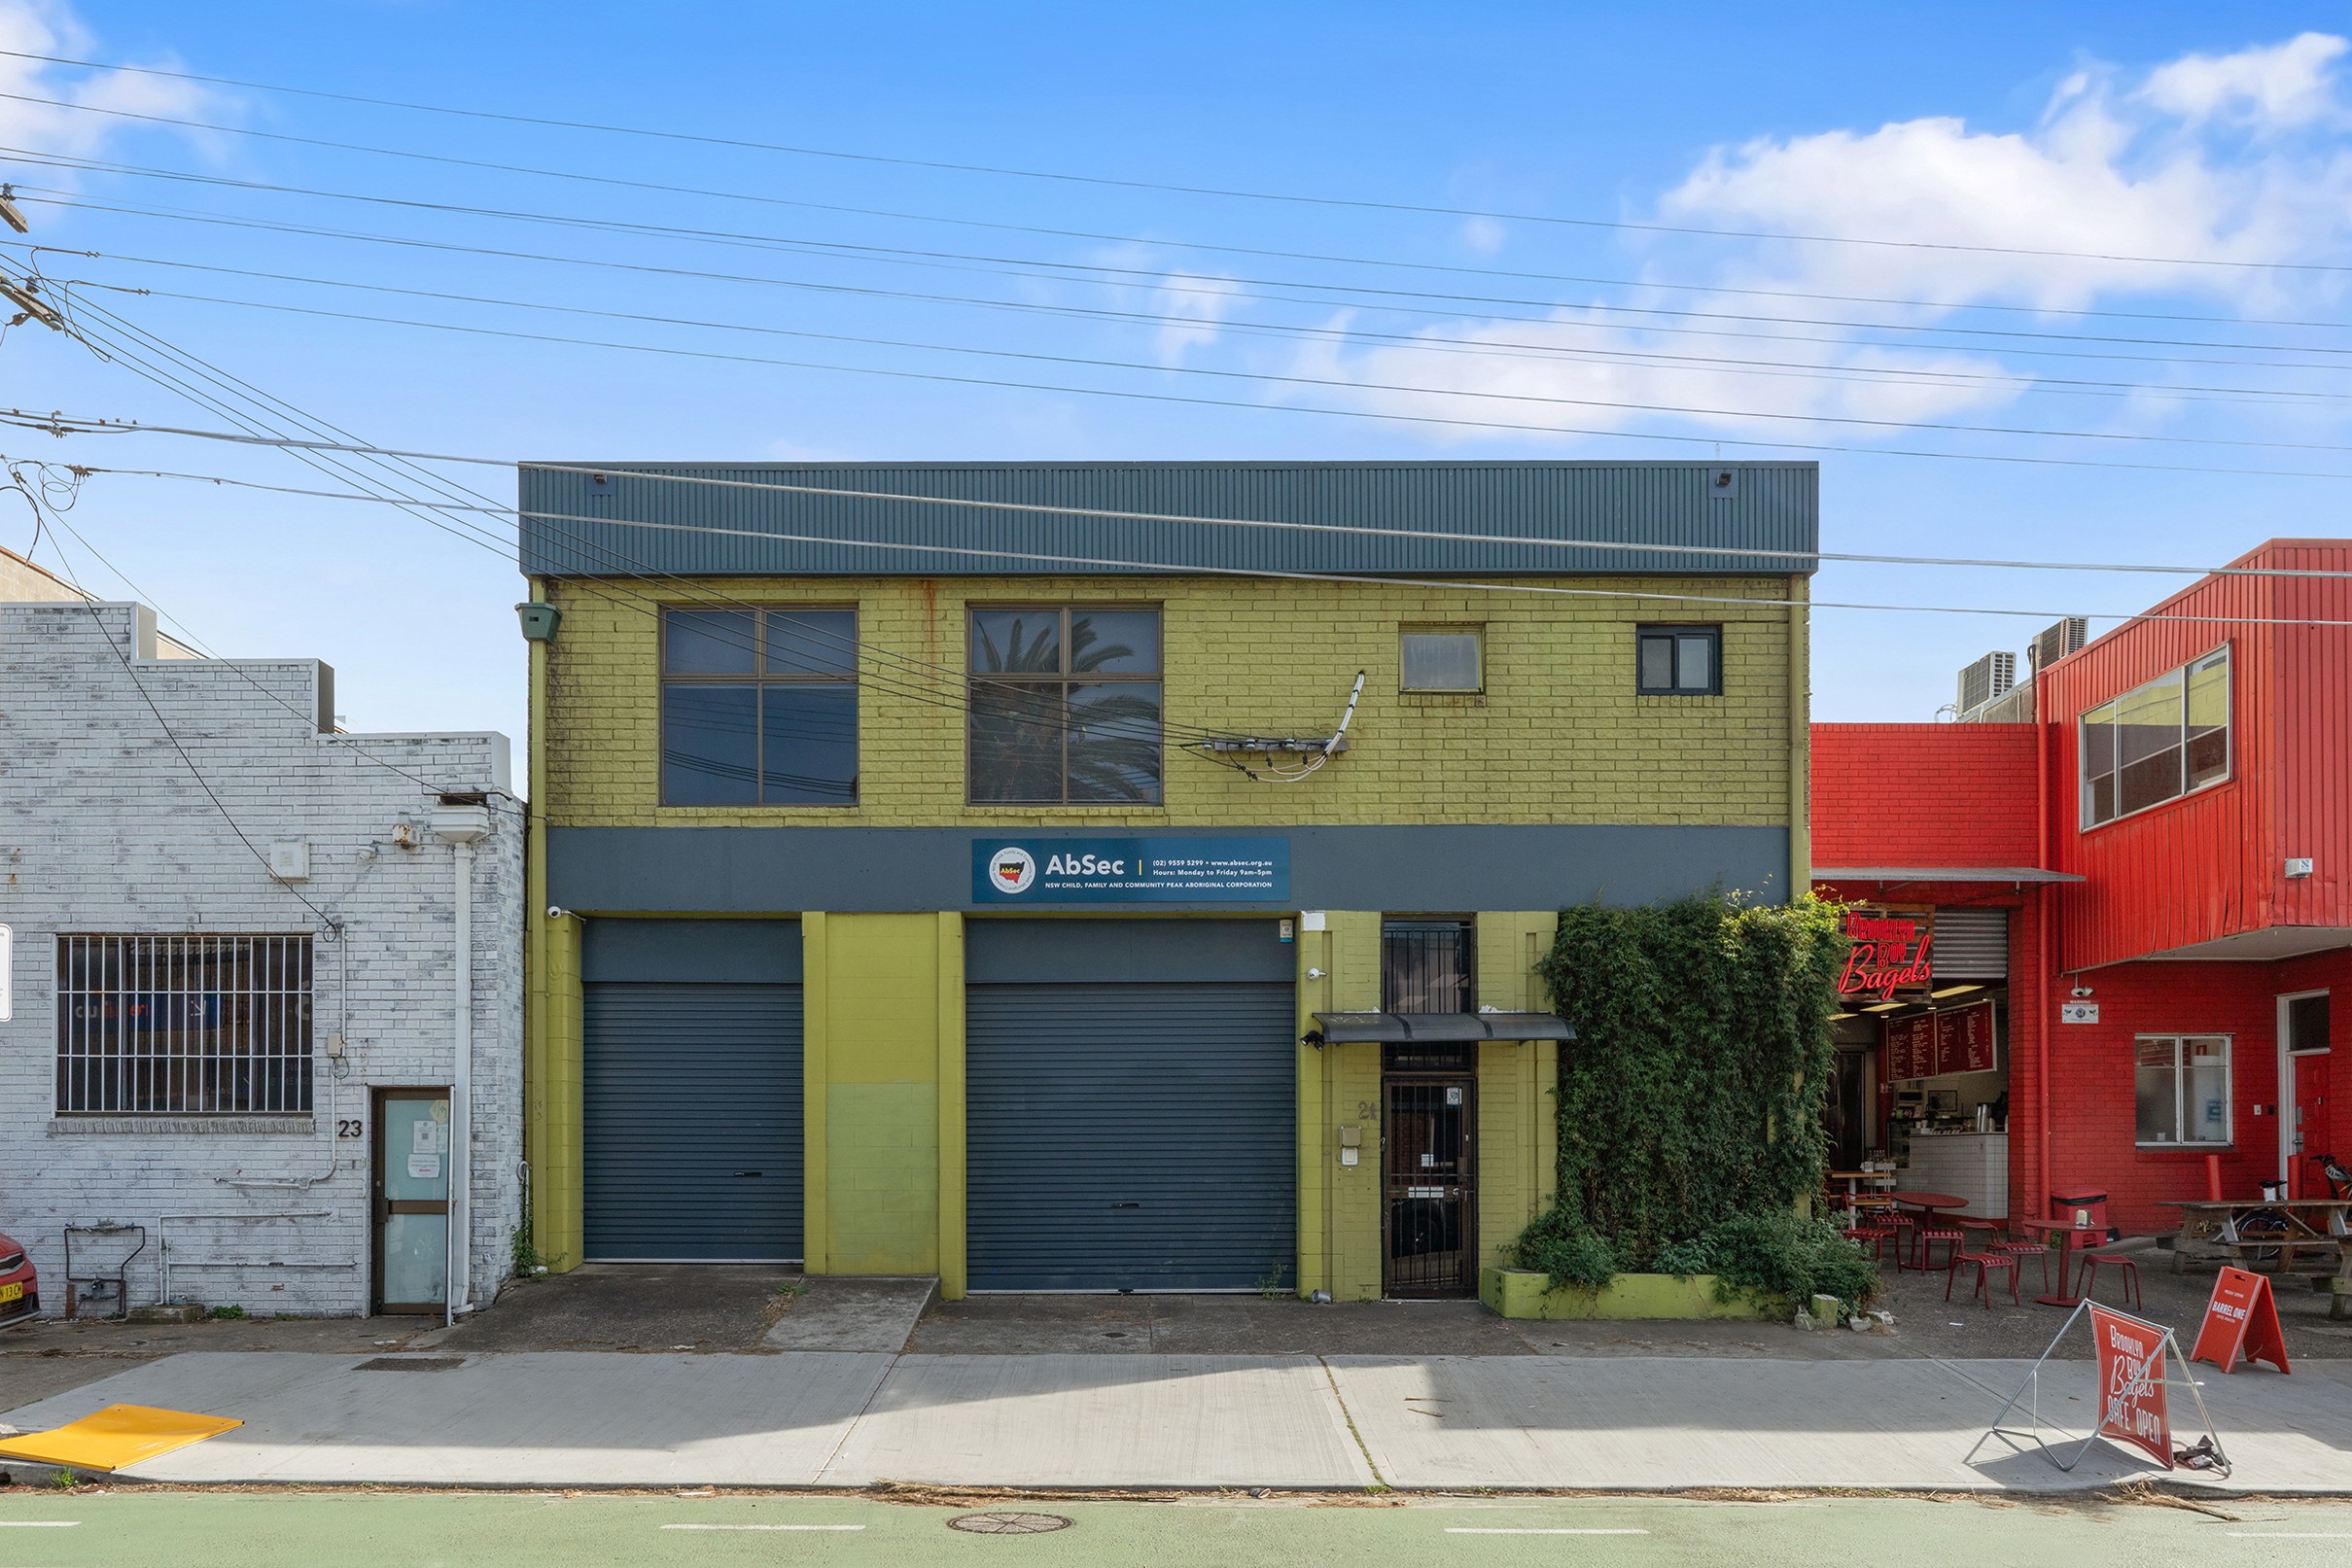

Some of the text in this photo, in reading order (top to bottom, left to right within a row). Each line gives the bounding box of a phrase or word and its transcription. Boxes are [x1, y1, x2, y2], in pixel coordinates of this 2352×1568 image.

[1045, 854, 1124, 875] AbSec
[1838, 934, 1930, 1000] Bagels
[1877, 942, 1907, 970] BOY
[337, 1119, 363, 1138] 23
[2212, 1301, 2233, 1317] BARREL
[2232, 1307, 2246, 1320] ONE
[2110, 1325, 2144, 1359] BROOKLYN
[2135, 1407, 2161, 1446] OPEN
